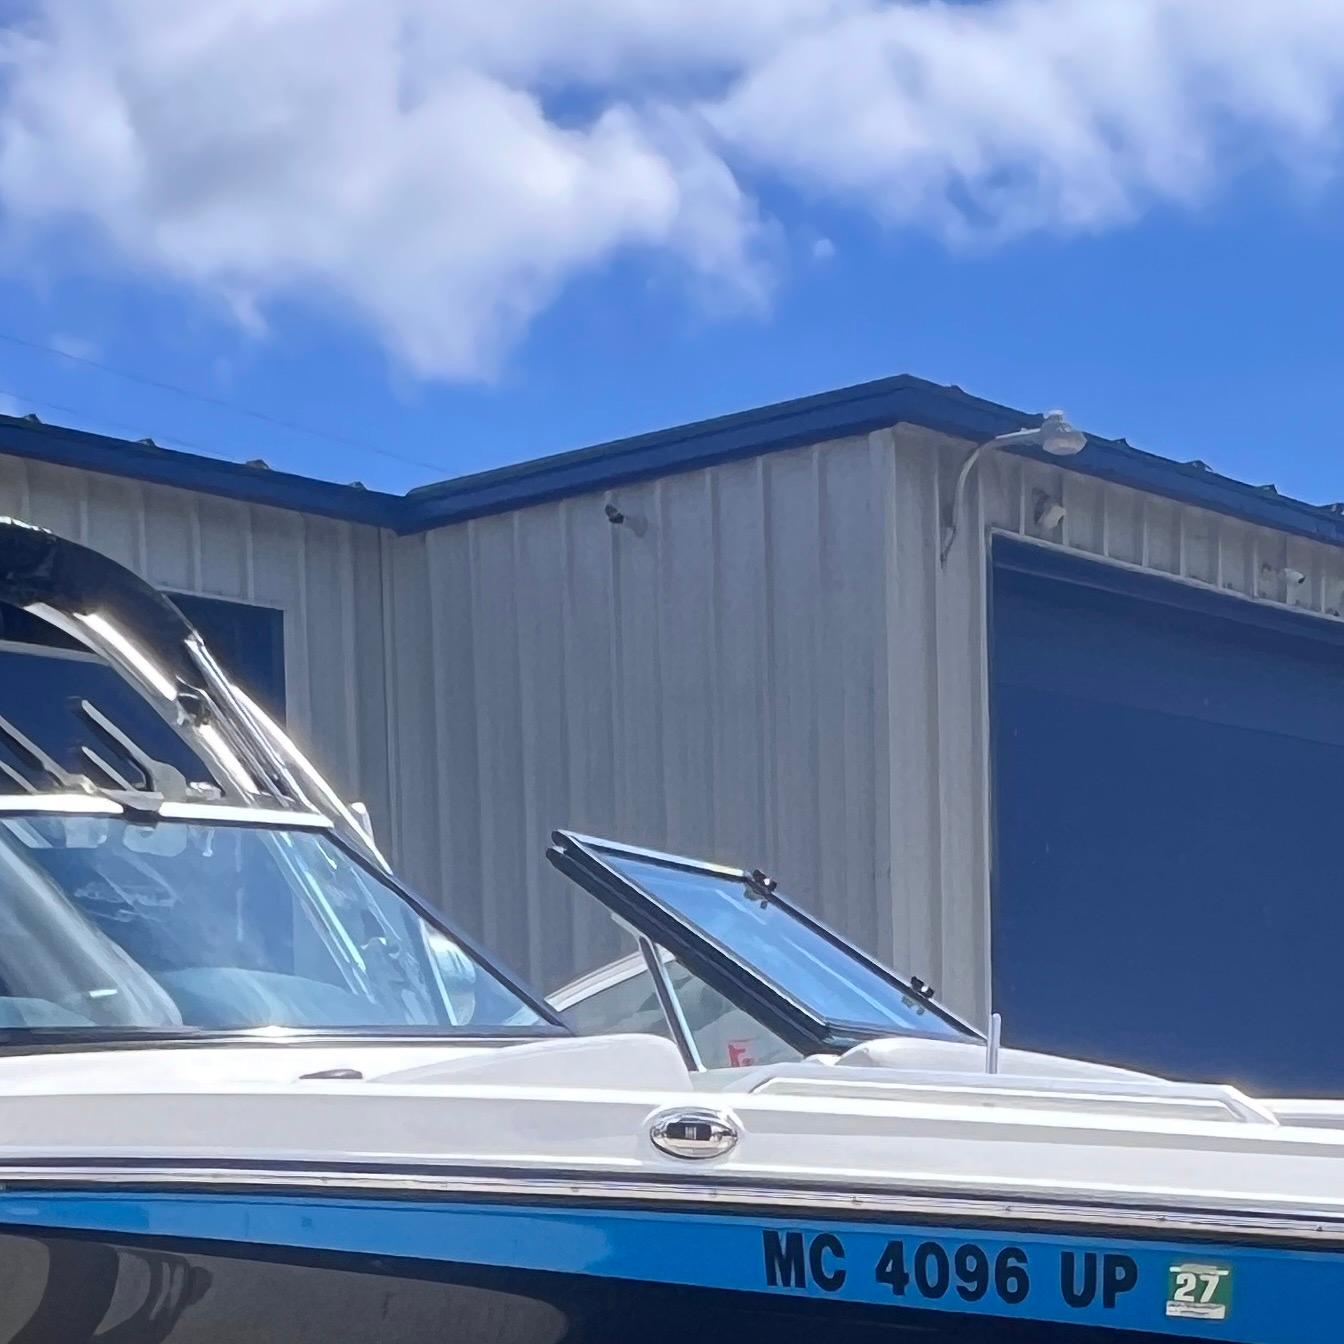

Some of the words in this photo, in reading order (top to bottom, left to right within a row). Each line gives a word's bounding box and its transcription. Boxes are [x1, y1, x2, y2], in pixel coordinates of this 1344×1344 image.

[762, 1229, 846, 1292] MC
[875, 1240, 1030, 1304] 4096
[1060, 1251, 1137, 1308] UP
[1174, 1272, 1219, 1303] 27
